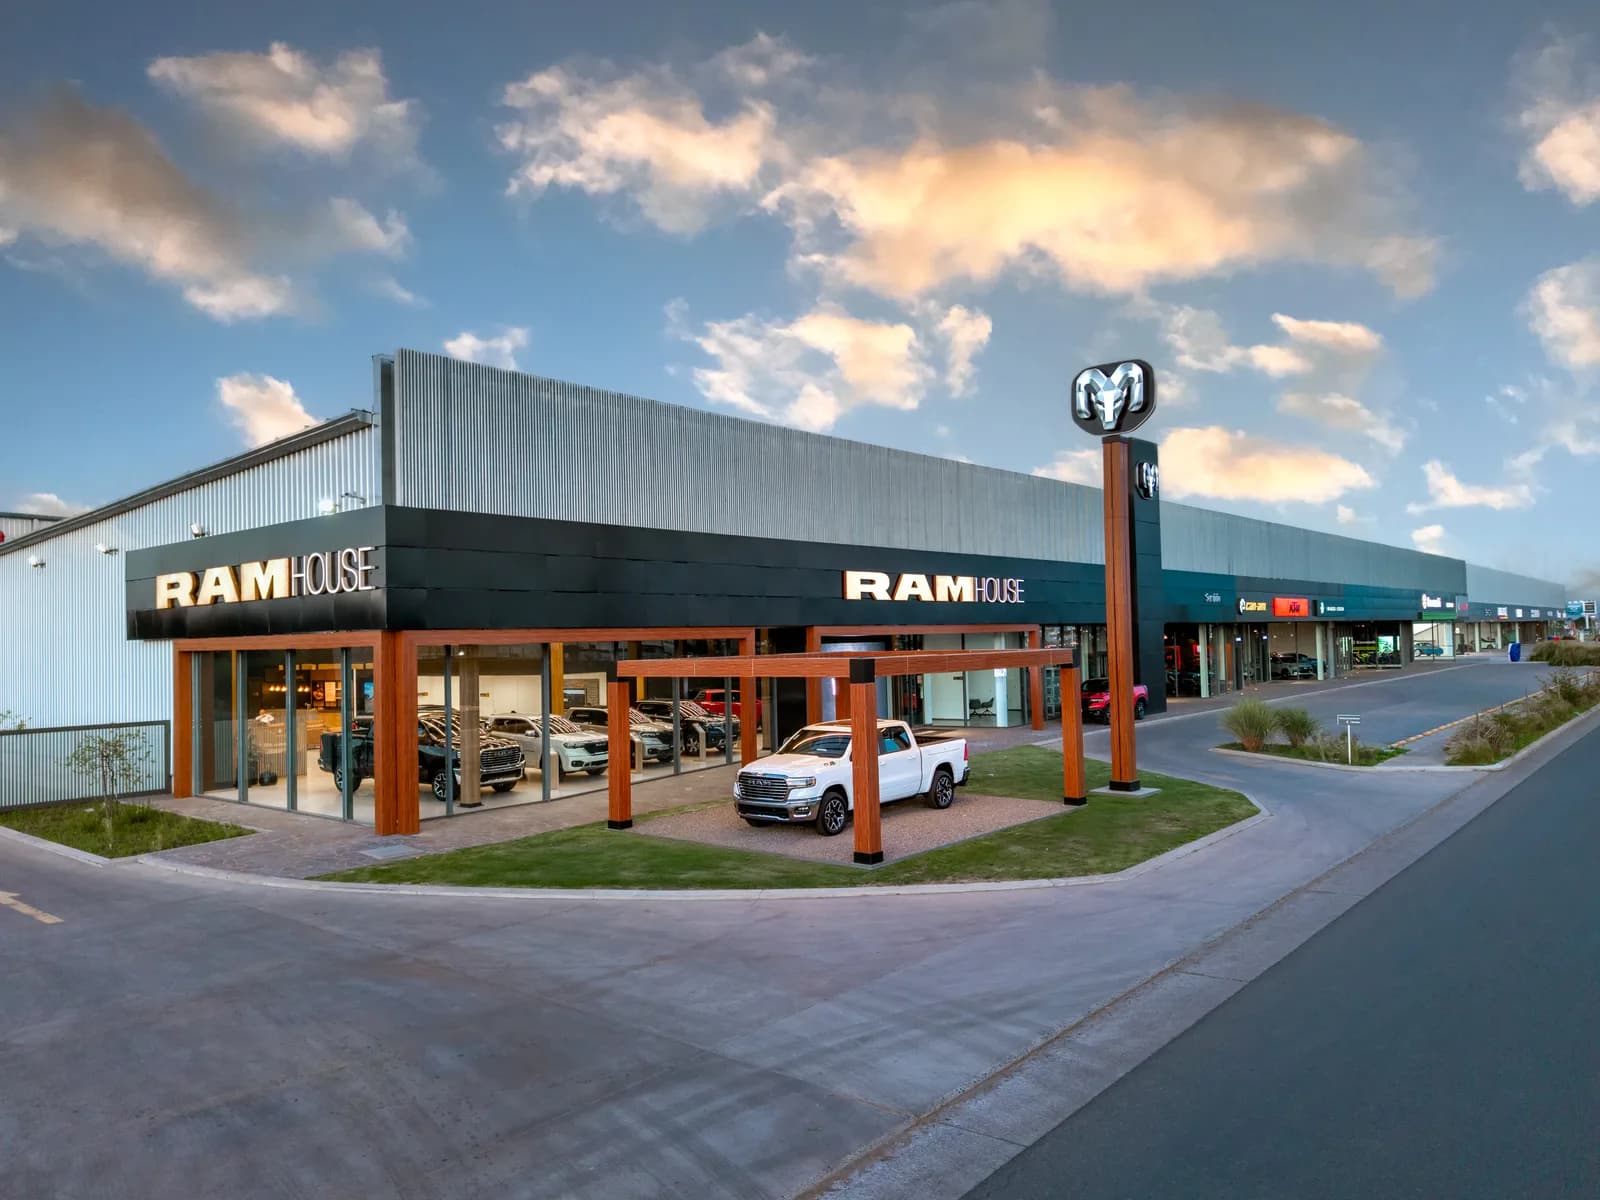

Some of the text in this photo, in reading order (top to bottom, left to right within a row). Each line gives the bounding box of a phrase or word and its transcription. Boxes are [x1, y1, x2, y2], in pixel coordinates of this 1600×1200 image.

[156, 546, 375, 609] RAM HOUSE
[843, 570, 1025, 603] RAM HOUSE
